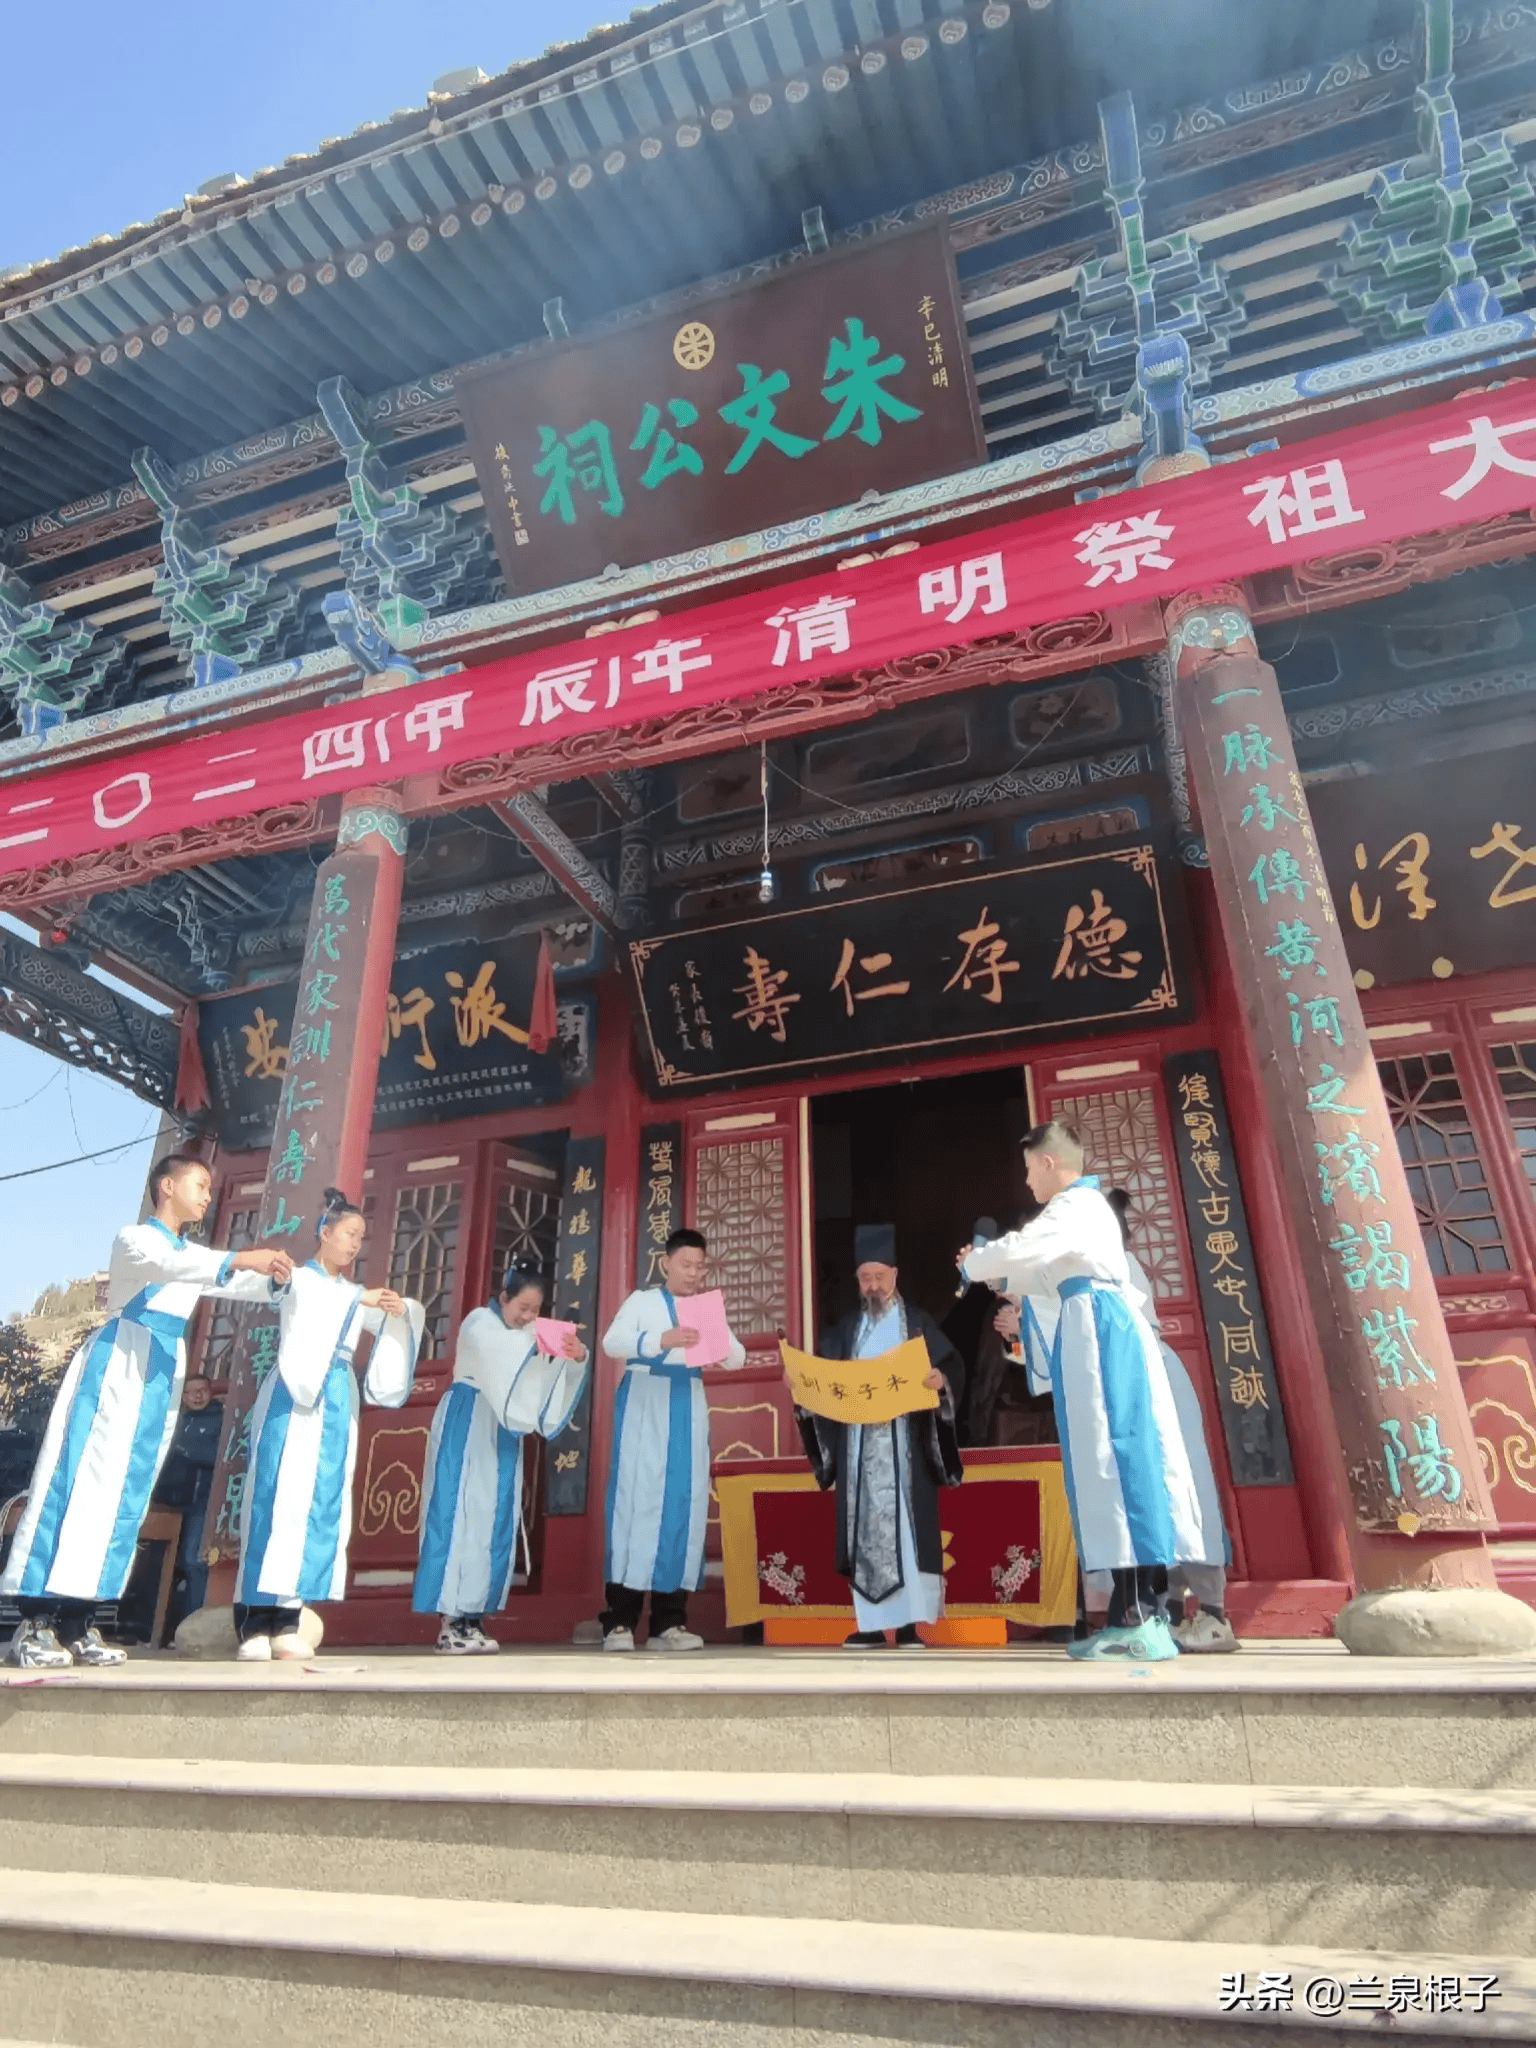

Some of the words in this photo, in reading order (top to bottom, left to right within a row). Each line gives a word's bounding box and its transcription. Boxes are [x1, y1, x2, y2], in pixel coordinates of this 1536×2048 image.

[918, 295, 949, 388] 辛巳清明
[533, 317, 923, 525] 朱文公祠
[732, 889, 1143, 1042] 德存仁壽
